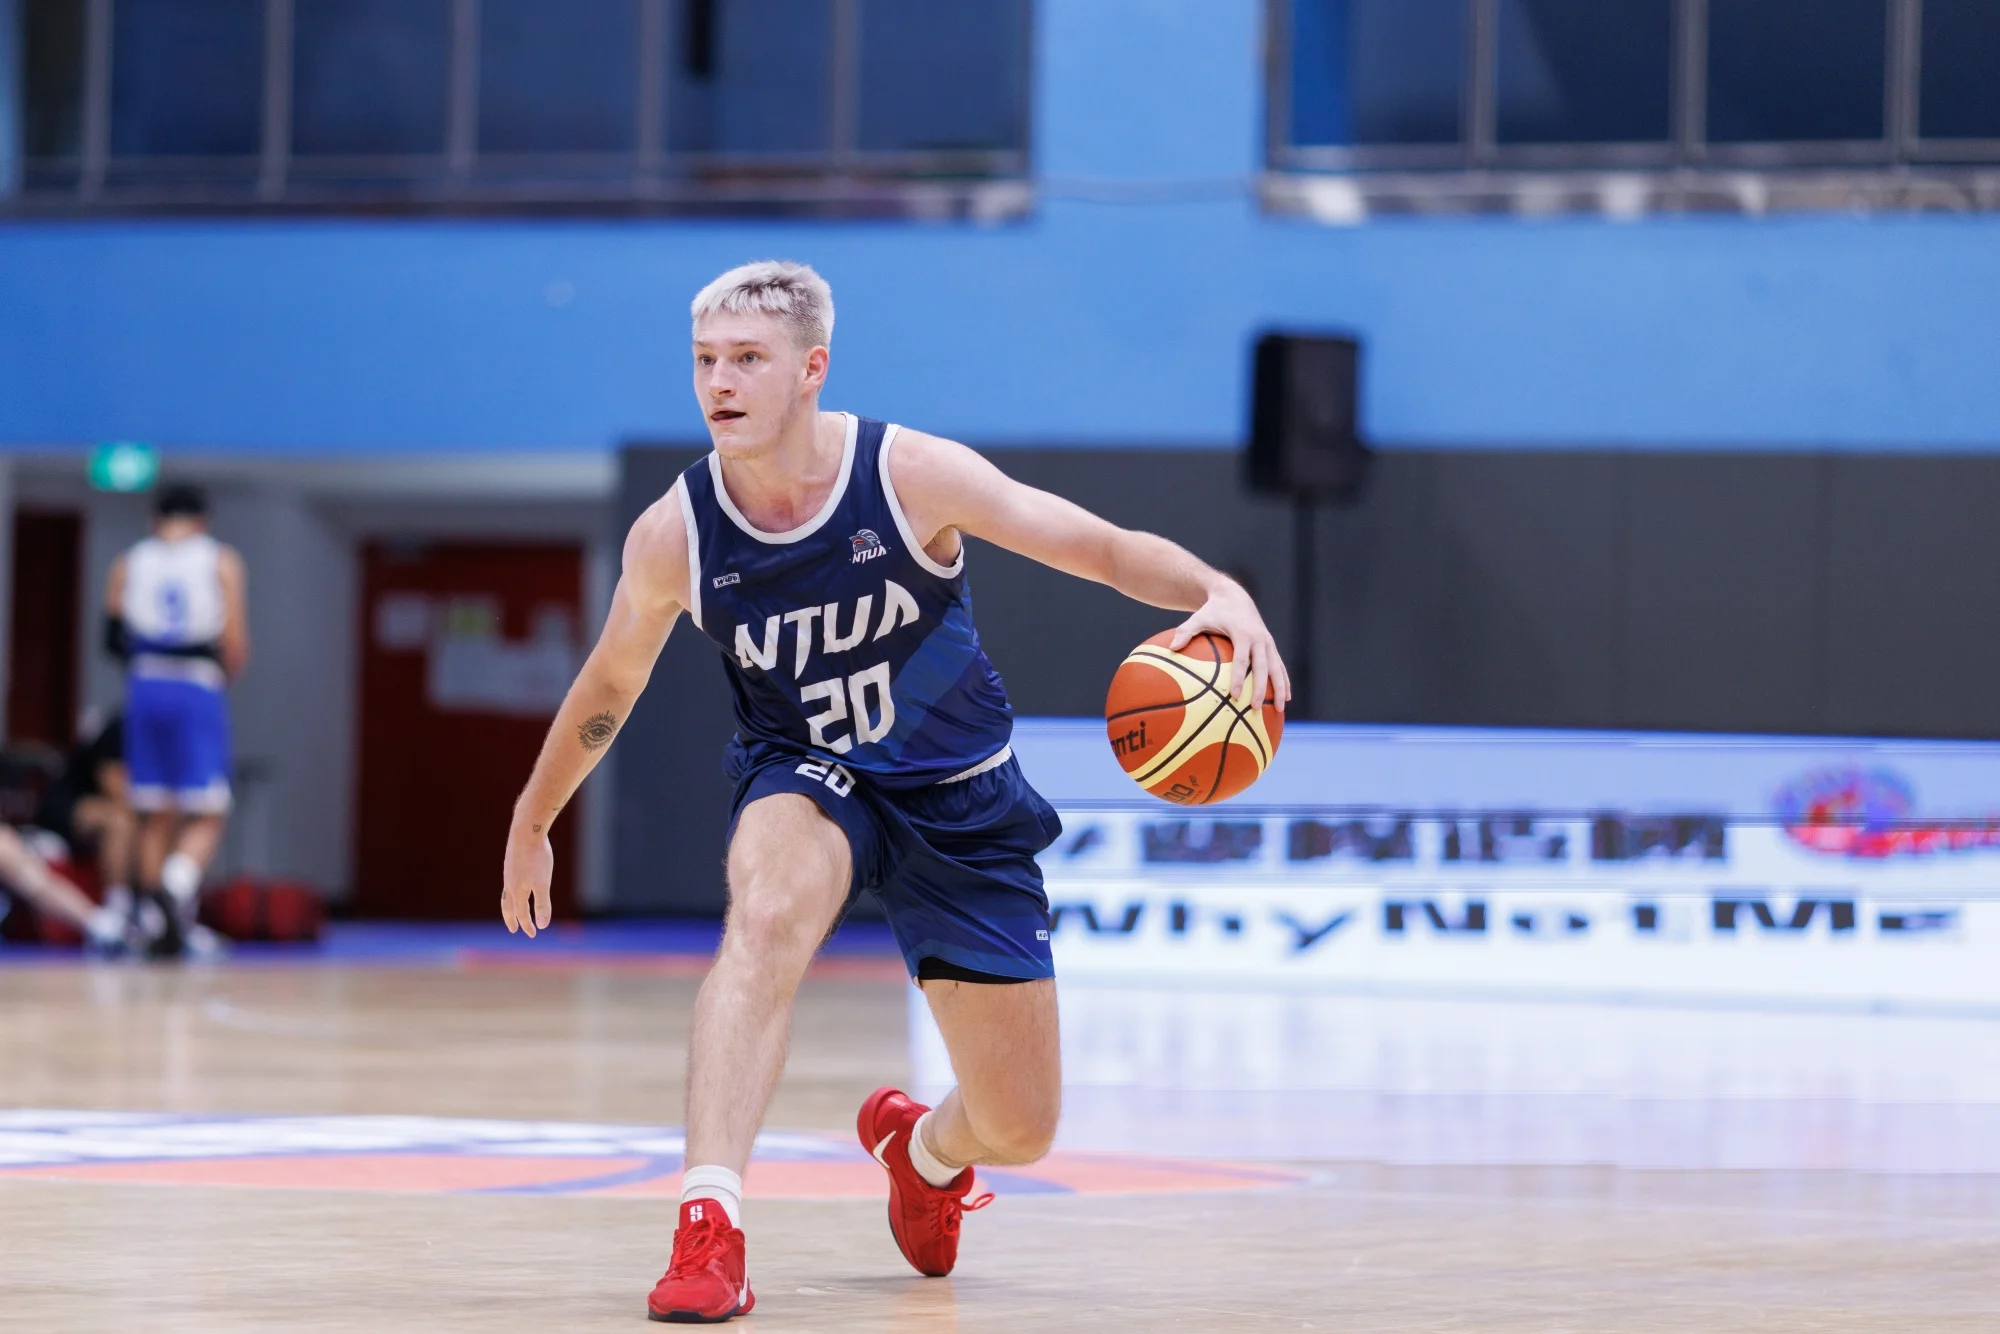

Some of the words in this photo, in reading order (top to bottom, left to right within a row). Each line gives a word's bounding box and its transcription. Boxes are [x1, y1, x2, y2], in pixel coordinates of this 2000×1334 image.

[852, 545, 887, 564] NTUA
[735, 579, 920, 680] NTUA
[800, 661, 896, 755] 20
[794, 754, 857, 798] 20
